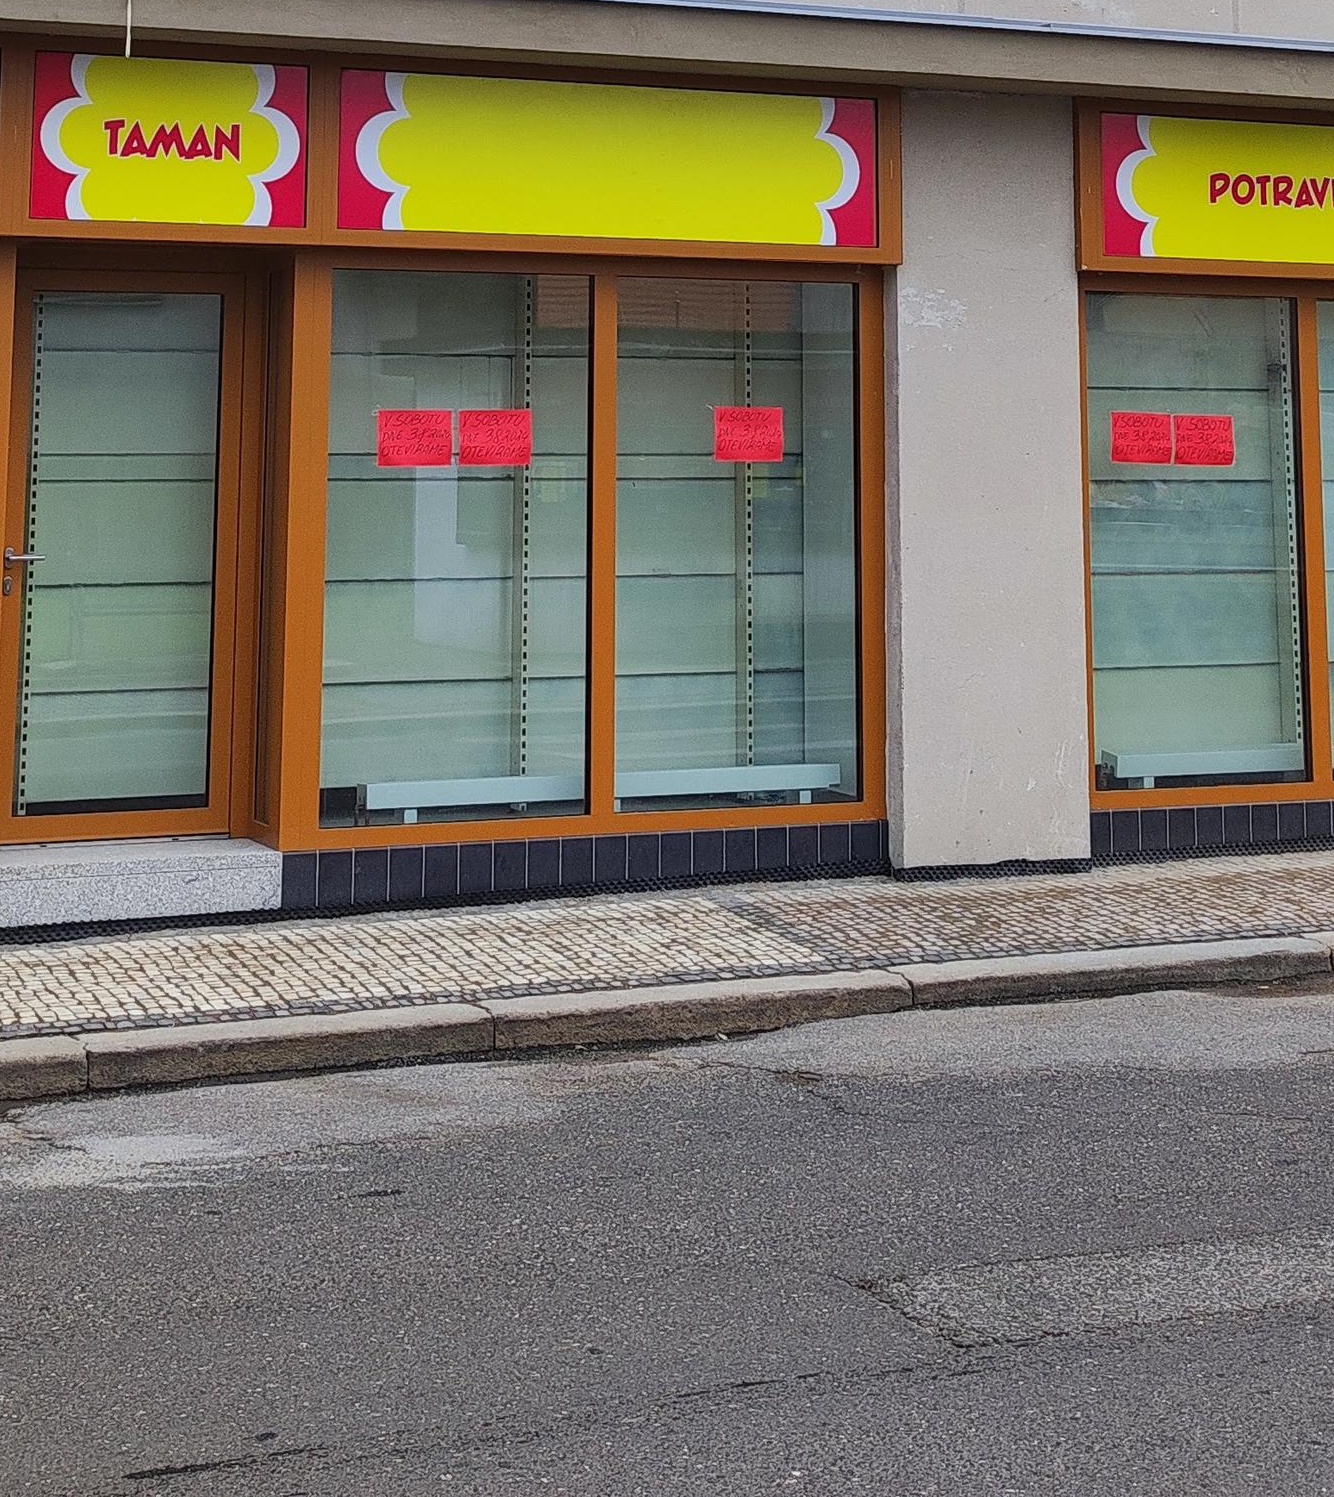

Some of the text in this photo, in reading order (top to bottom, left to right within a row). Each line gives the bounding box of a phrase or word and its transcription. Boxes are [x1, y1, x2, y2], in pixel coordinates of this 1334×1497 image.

[103, 118, 241, 162] TAMAN
[393, 413, 446, 427] SOBOTU
[470, 412, 525, 427] SOBOTU
